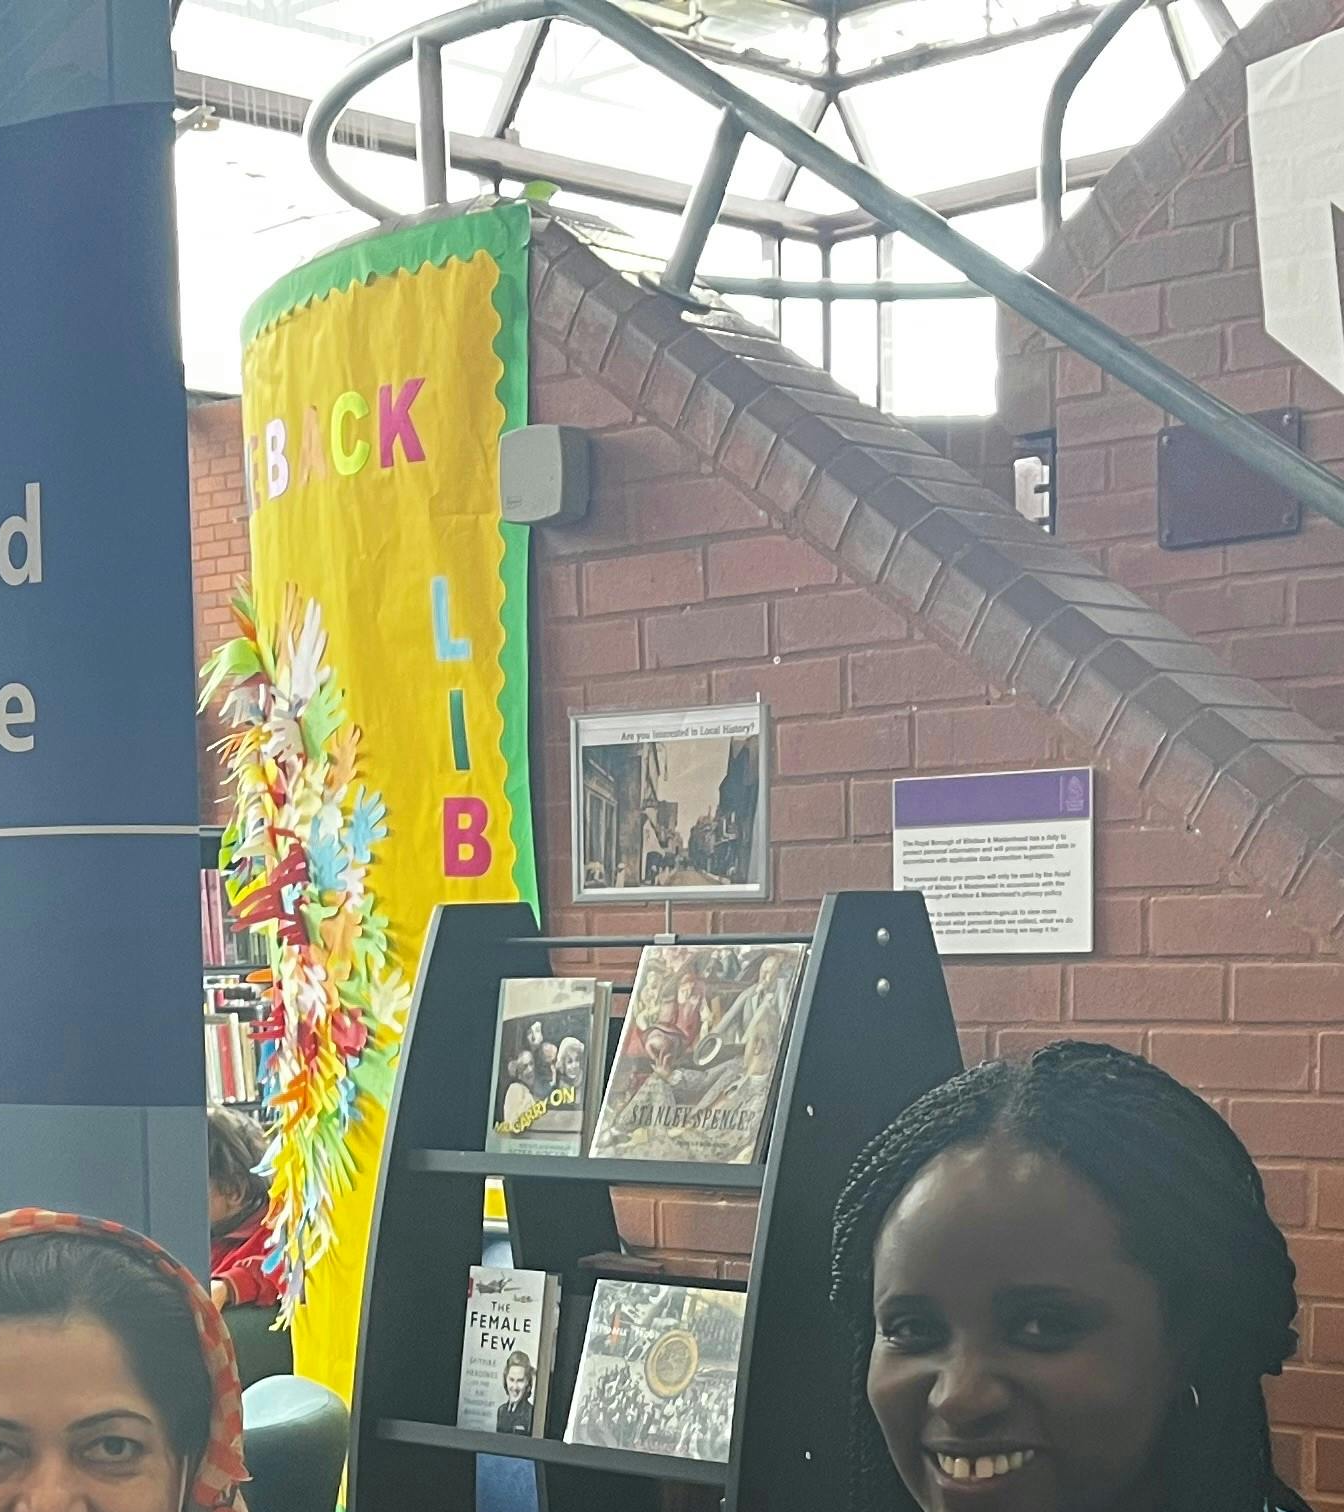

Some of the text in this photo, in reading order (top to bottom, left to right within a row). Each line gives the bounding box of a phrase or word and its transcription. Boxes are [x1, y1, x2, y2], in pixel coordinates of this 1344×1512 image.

[550, 1086, 575, 1106] ON
[632, 1104, 692, 1128] STANLEY
[491, 1301, 511, 1313] THE
[470, 1311, 532, 1333] FEMALE
[480, 1333, 516, 1351] FEW
